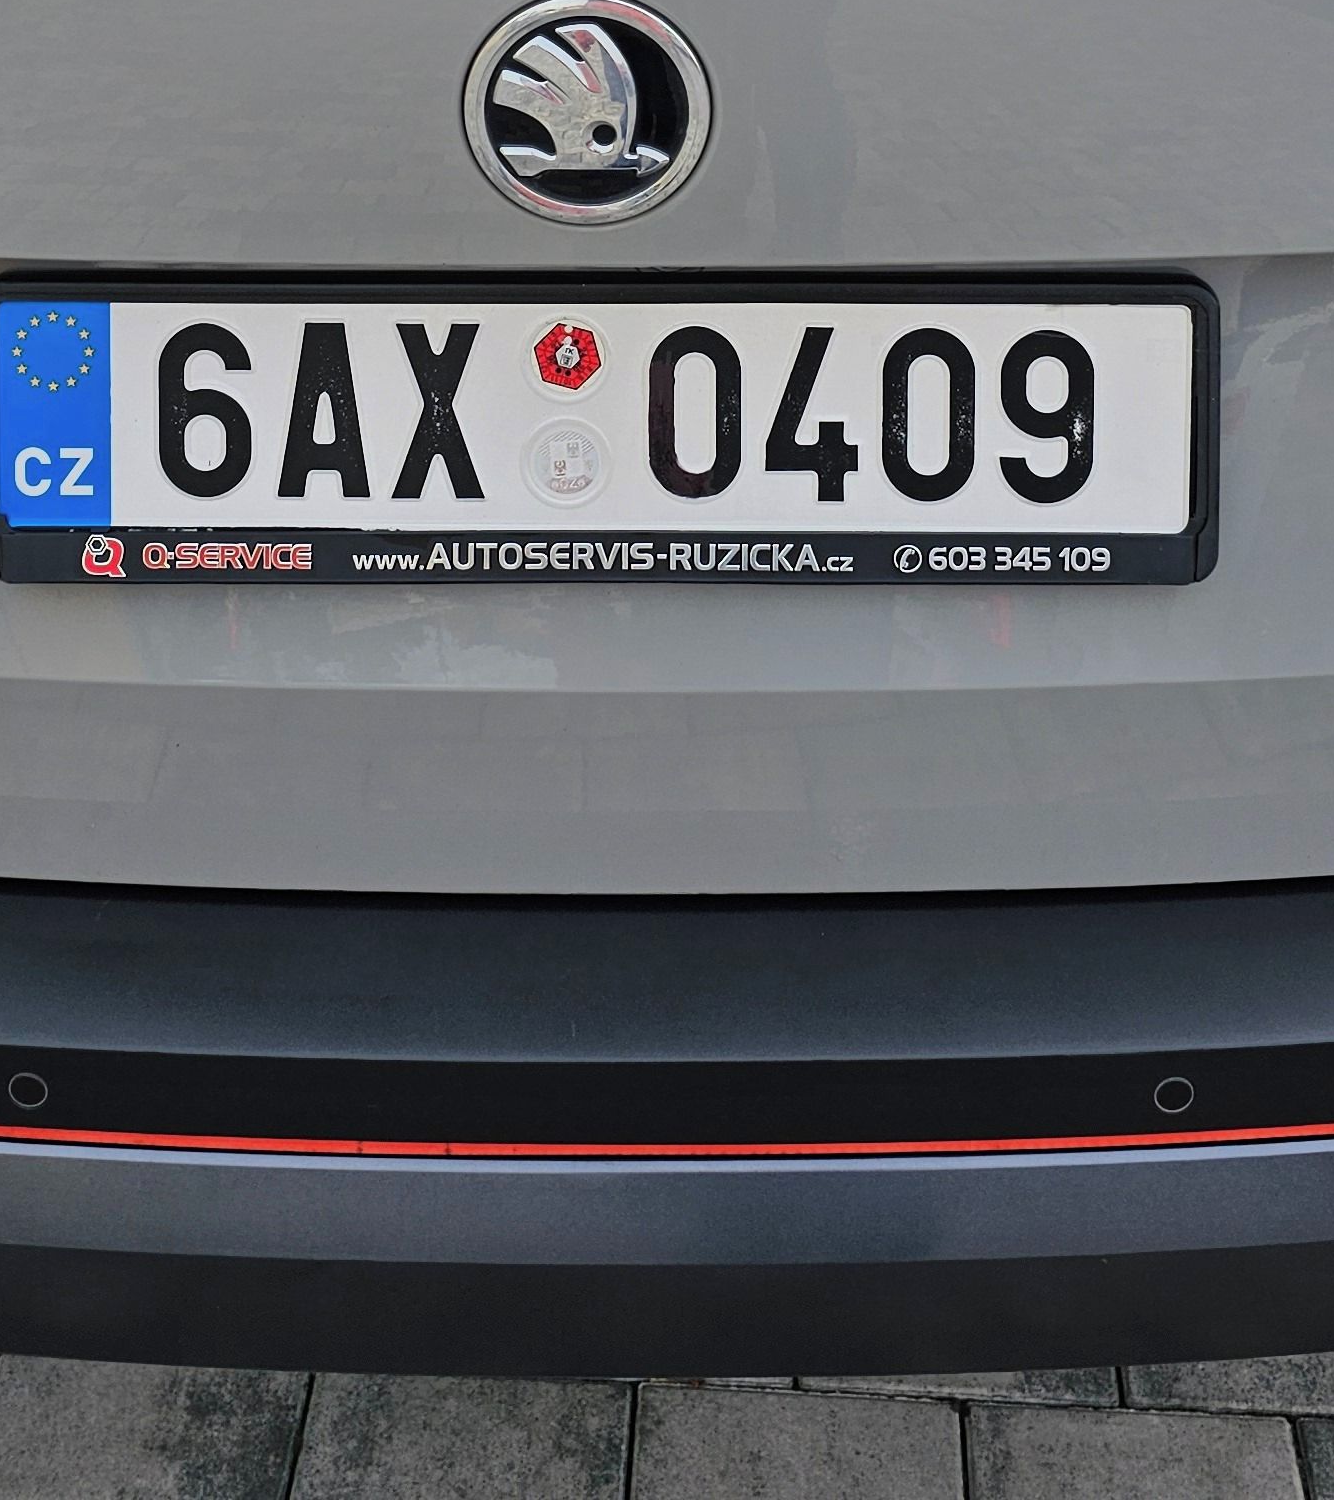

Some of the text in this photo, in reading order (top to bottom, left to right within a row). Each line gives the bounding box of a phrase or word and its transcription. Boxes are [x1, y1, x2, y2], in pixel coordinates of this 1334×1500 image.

[158, 322, 1095, 504] 6AX 0409
[13, 446, 94, 498] CZ
[352, 541, 854, 573] www.AUTOSERVIS-RUZICKA.cz
[928, 546, 1111, 572] 603 345 109
